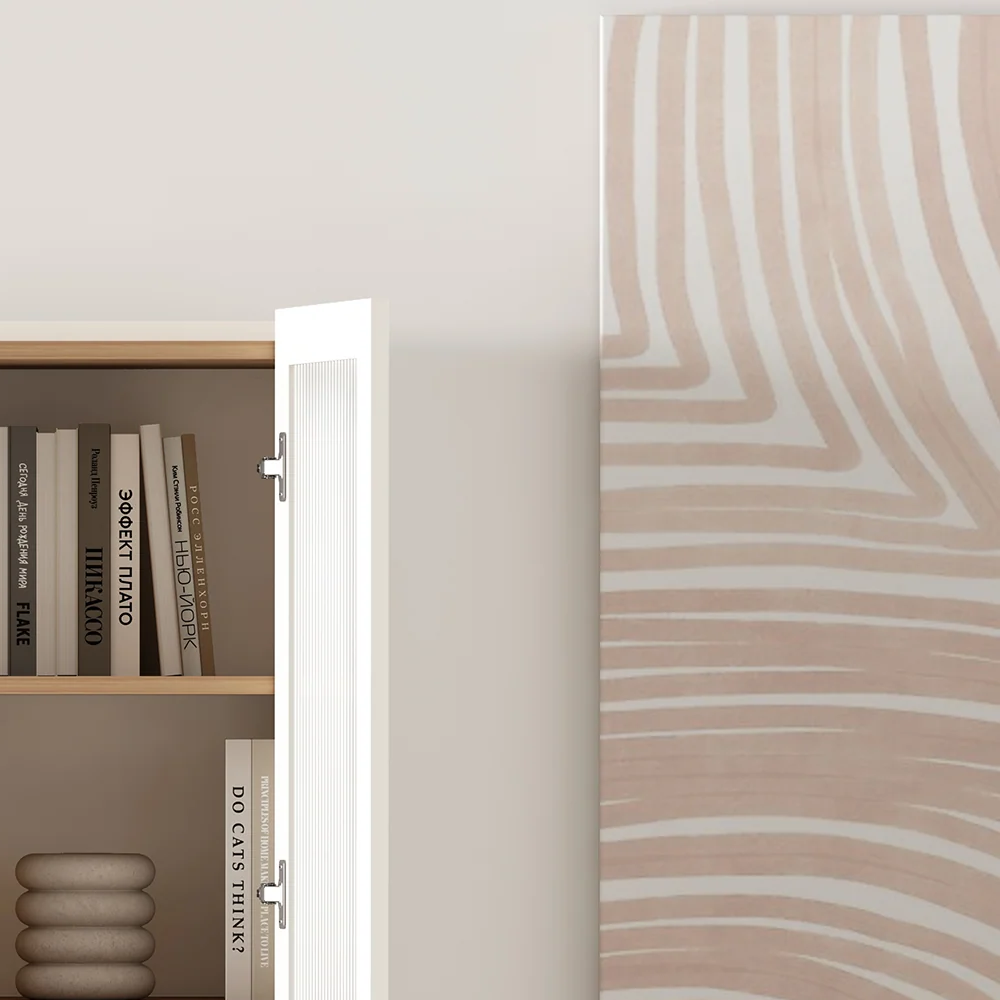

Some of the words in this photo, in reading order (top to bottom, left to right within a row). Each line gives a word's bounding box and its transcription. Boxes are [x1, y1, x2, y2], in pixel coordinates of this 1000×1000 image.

[90, 448, 101, 476] Роланд
[17, 463, 29, 497] СЕГОДНЯ
[89, 477, 100, 509] Пенроуз
[16, 500, 29, 522] ДЕНЬ
[174, 502, 183, 532] Робинсон
[189, 485, 200, 526] РОСС
[119, 489, 133, 560] ЭФФЕКТ
[17, 525, 29, 565] РОЖДЕНИЯ
[18, 567, 28, 588] МИРА
[193, 533, 209, 631] ЭЛЛЕНХОРН
[84, 547, 103, 646] ПИКАССО
[119, 567, 133, 626] ПЛАТО
[175, 540, 197, 650] НЬЮ-ЙОРК
[16, 602, 31, 646] FLAKE
[232, 786, 245, 814] DO
[232, 823, 245, 871] CATS
[261, 836, 269, 861] HOME
[232, 880, 245, 954] THINK?
[261, 906, 269, 936] PLACE
[261, 936, 269, 948] TO
[261, 948, 269, 967] LIVE
